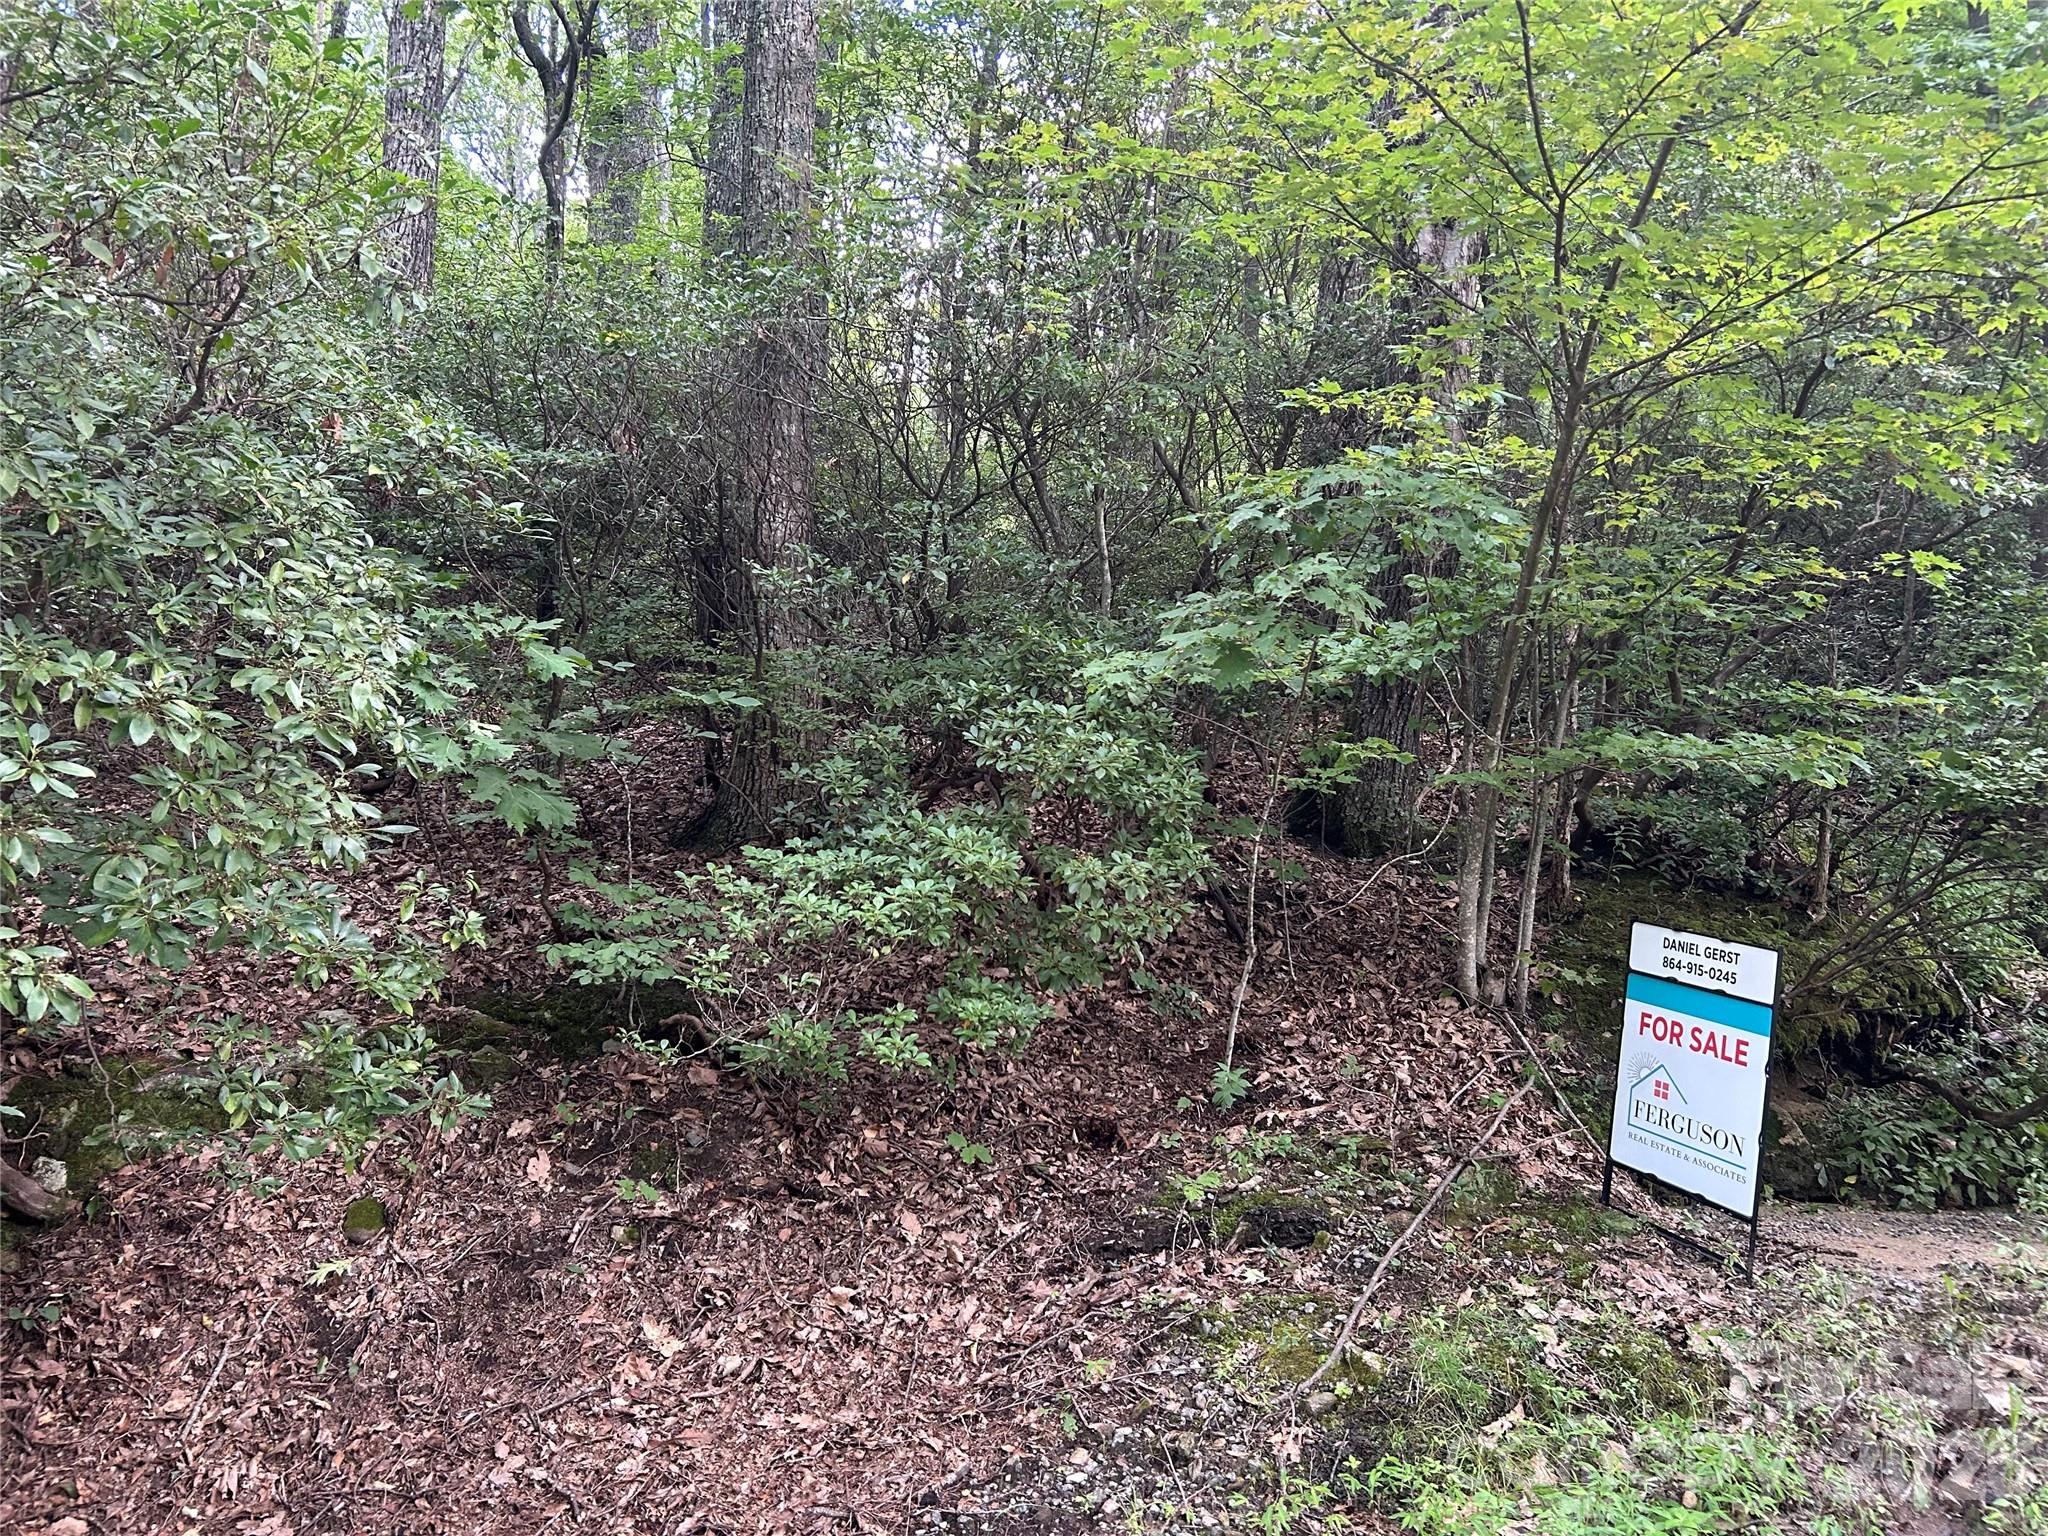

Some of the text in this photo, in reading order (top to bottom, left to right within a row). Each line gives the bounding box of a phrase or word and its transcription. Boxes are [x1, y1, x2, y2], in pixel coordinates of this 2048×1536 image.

[1662, 936, 1741, 966] DANIEL GERST
[1662, 956, 1737, 985] 864-915-0245
[1639, 1011, 1749, 1068] FOR SALE
[1633, 1098, 1746, 1158] FERGUSON
[1628, 1130, 1747, 1185] REAL ESTATE & ASSOCIATES
